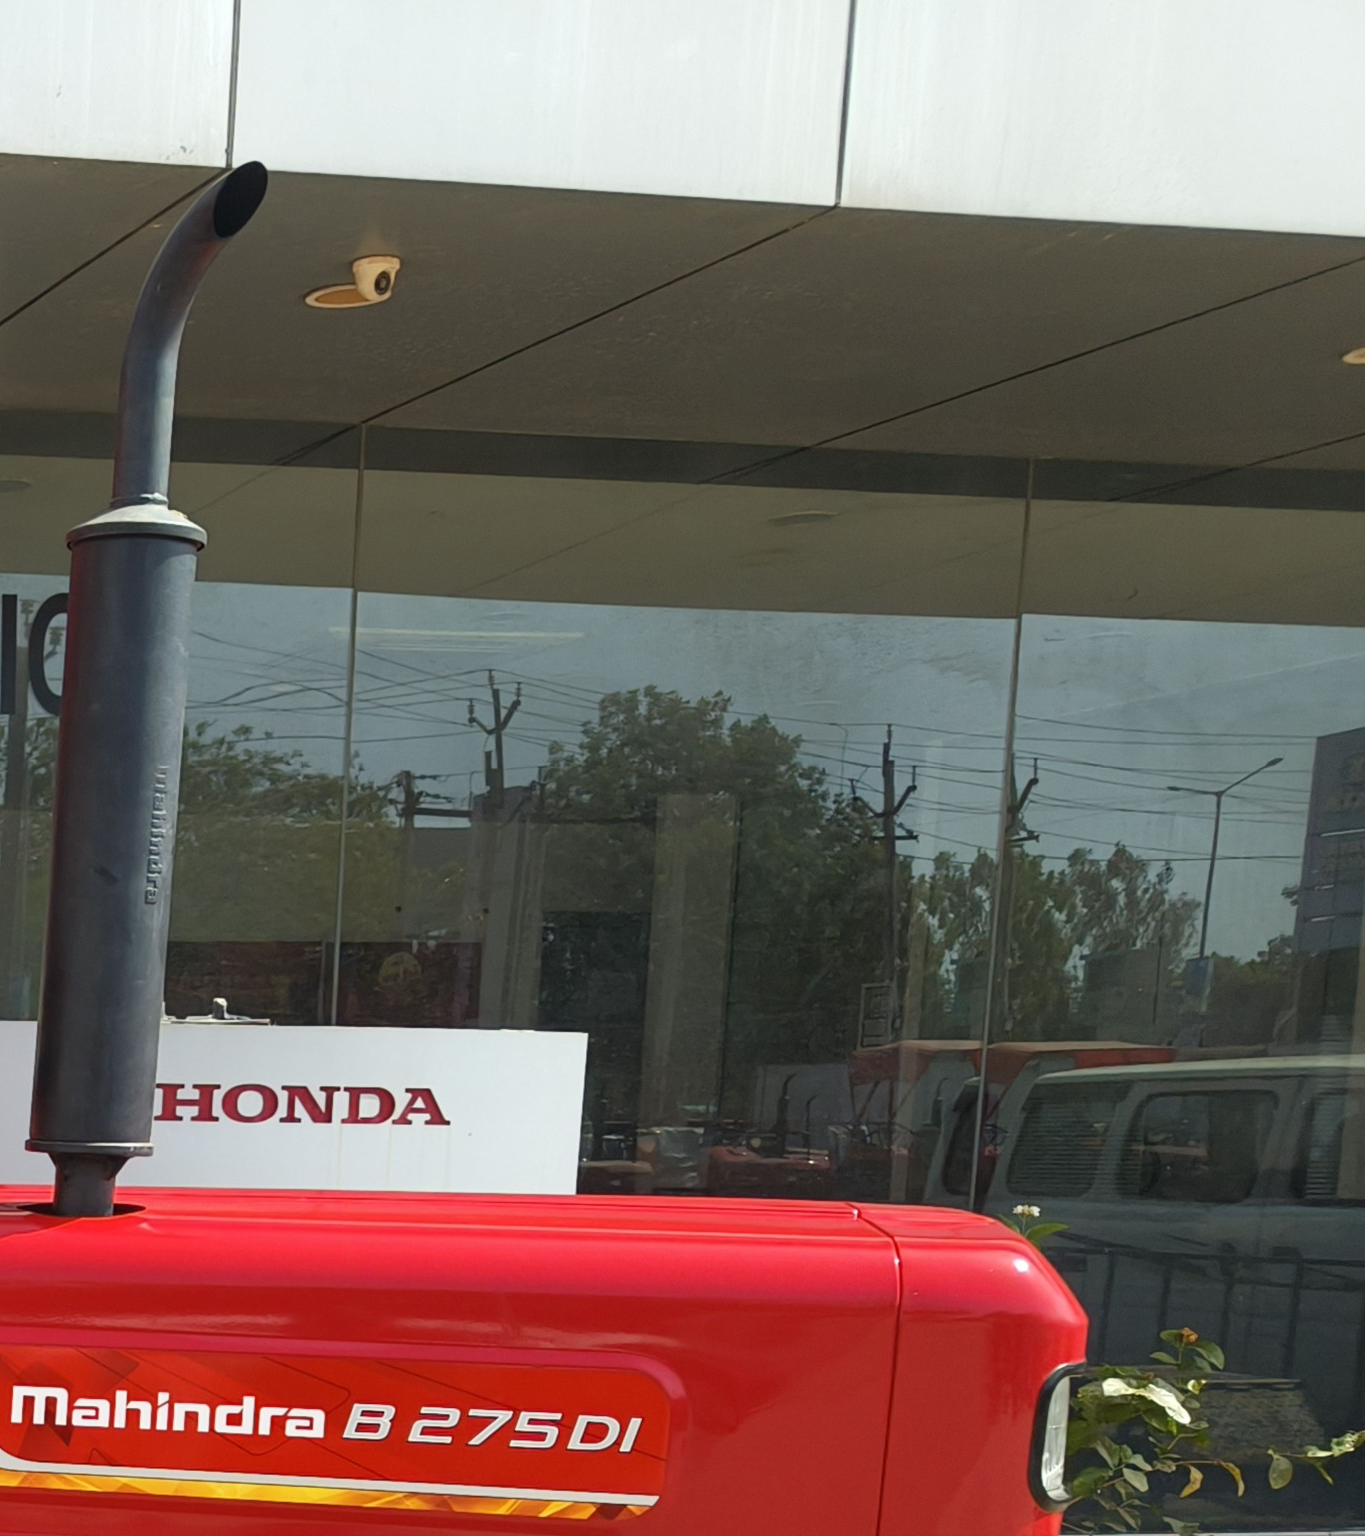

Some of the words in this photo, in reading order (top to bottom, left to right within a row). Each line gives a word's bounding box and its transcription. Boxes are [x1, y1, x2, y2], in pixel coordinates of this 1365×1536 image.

[156, 1083, 451, 1126] HONDA
[9, 1384, 327, 1440] Mahindra
[342, 1402, 397, 1442] B
